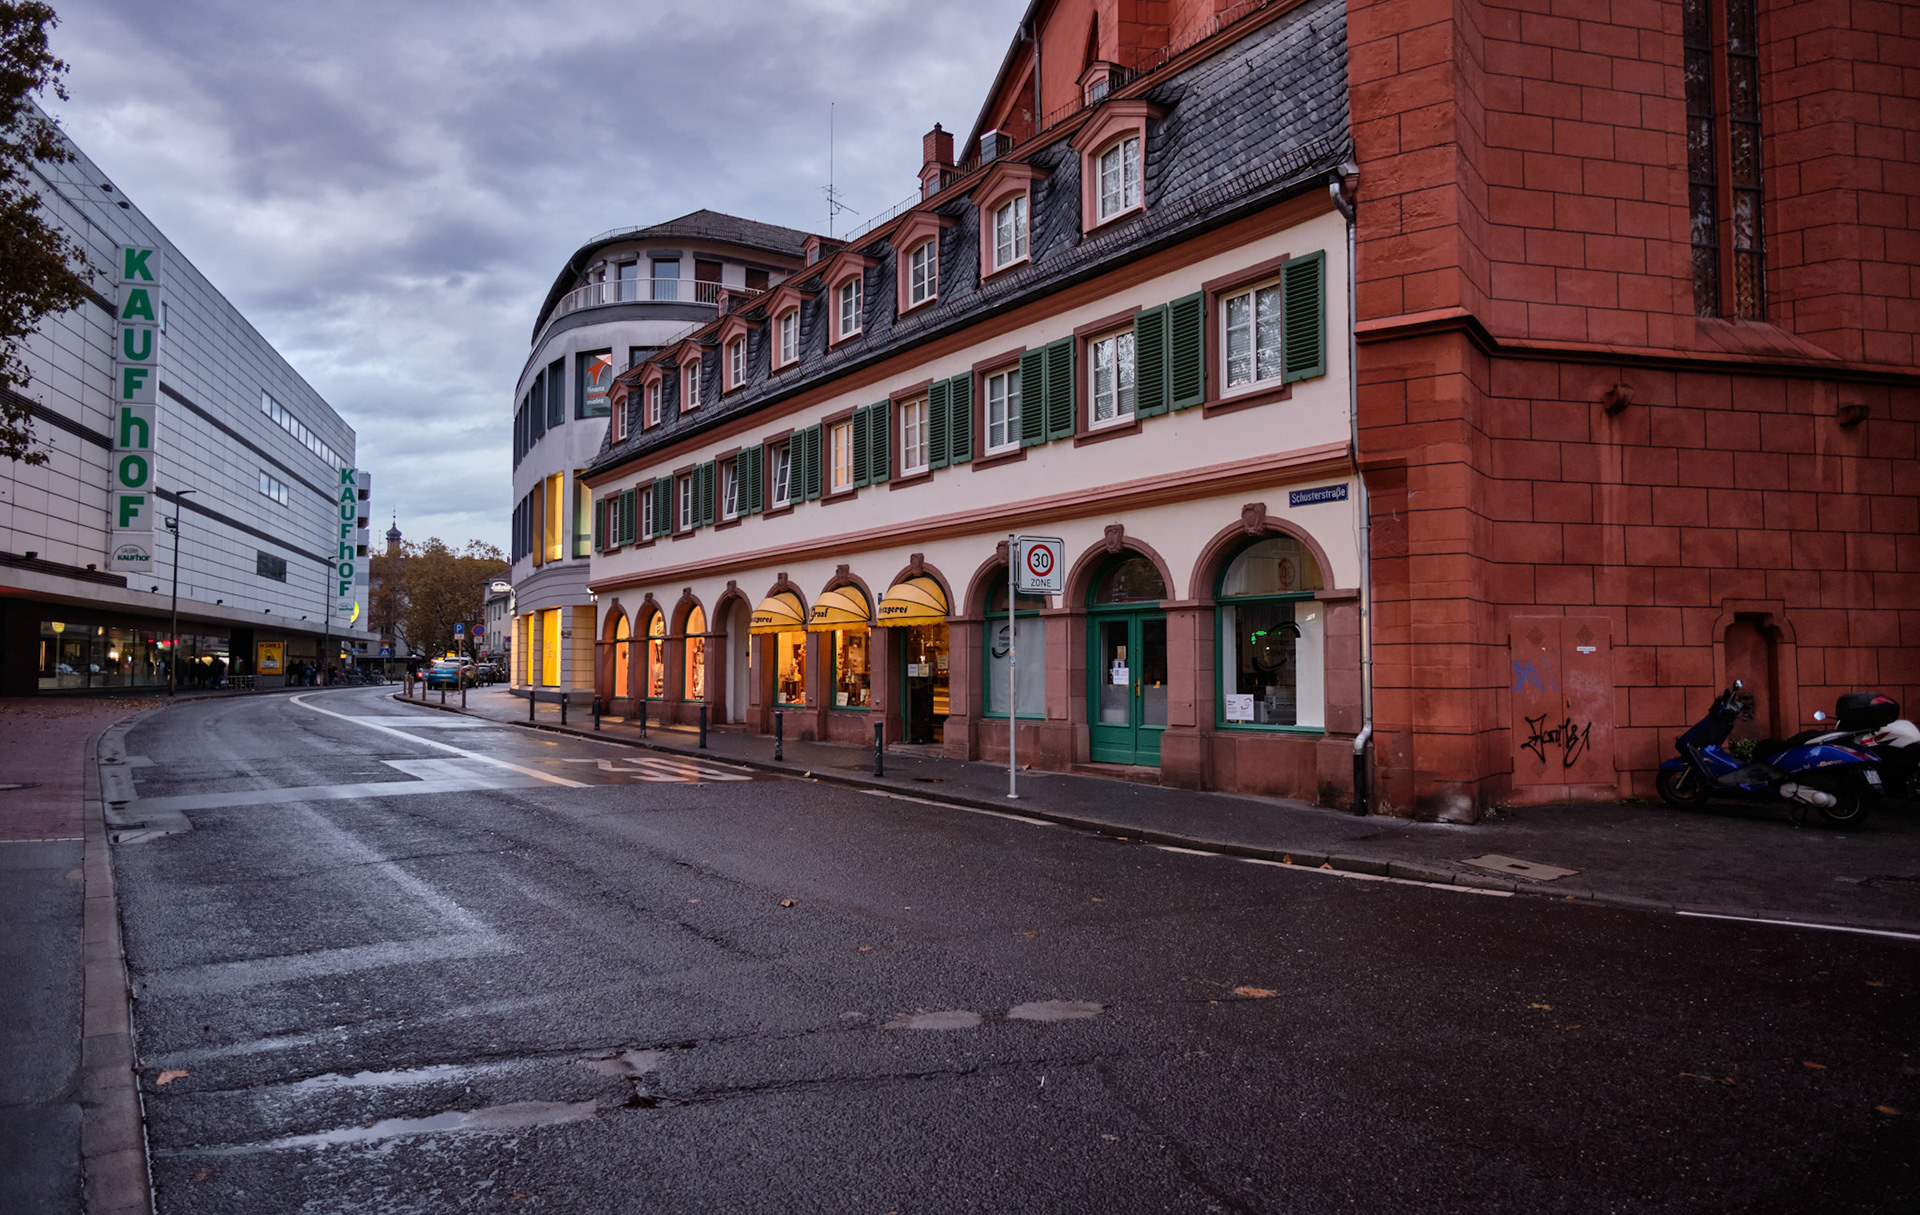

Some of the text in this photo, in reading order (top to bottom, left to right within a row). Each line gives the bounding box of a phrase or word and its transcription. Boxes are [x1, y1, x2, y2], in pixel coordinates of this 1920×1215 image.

[119, 248, 154, 527] KAUFhOF
[1291, 487, 1346, 503] Schusterstraße
[339, 468, 356, 596] KAUFhOF
[1033, 553, 1049, 568] 30
[1030, 578, 1051, 588] ZONE
[456, 624, 463, 634] P
